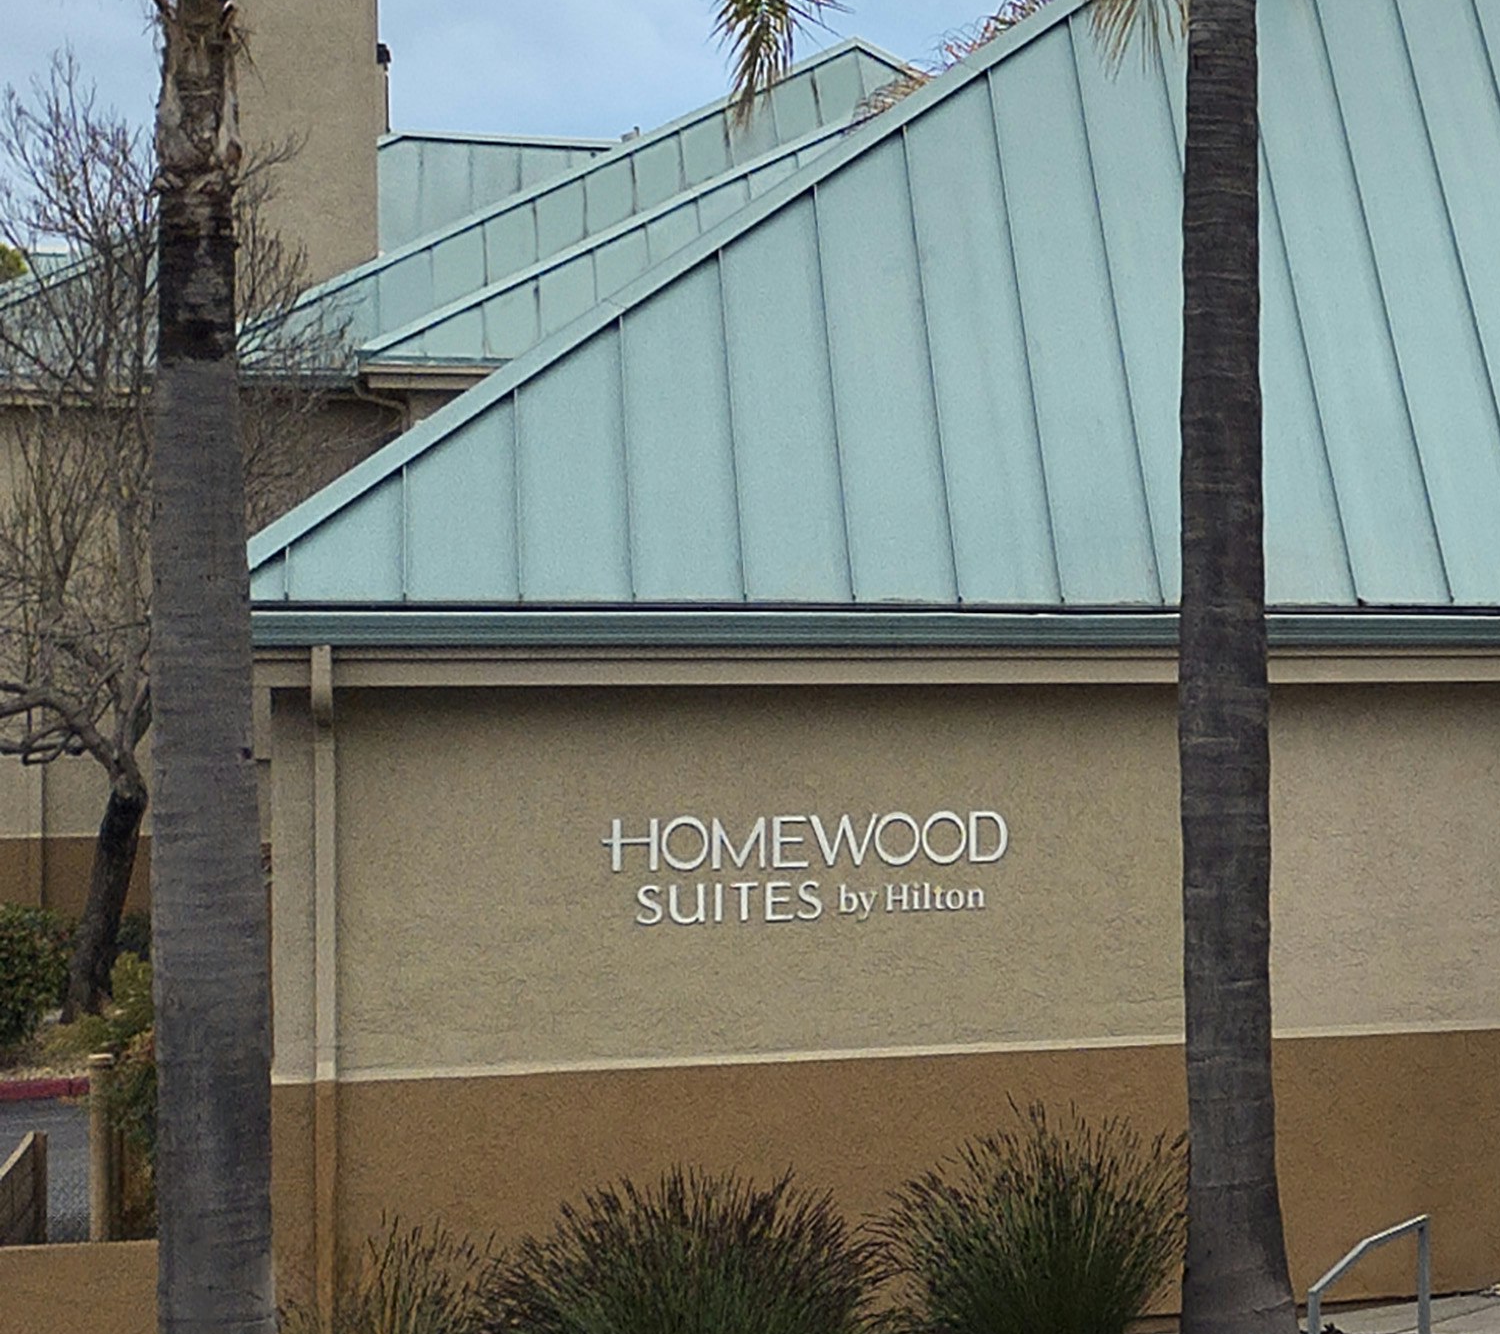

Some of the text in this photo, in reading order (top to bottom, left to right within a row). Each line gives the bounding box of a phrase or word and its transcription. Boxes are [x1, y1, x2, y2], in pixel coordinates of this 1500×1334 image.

[601, 810, 1008, 871] HOMEWOOD
[636, 880, 986, 924] SUITES by Hilton
